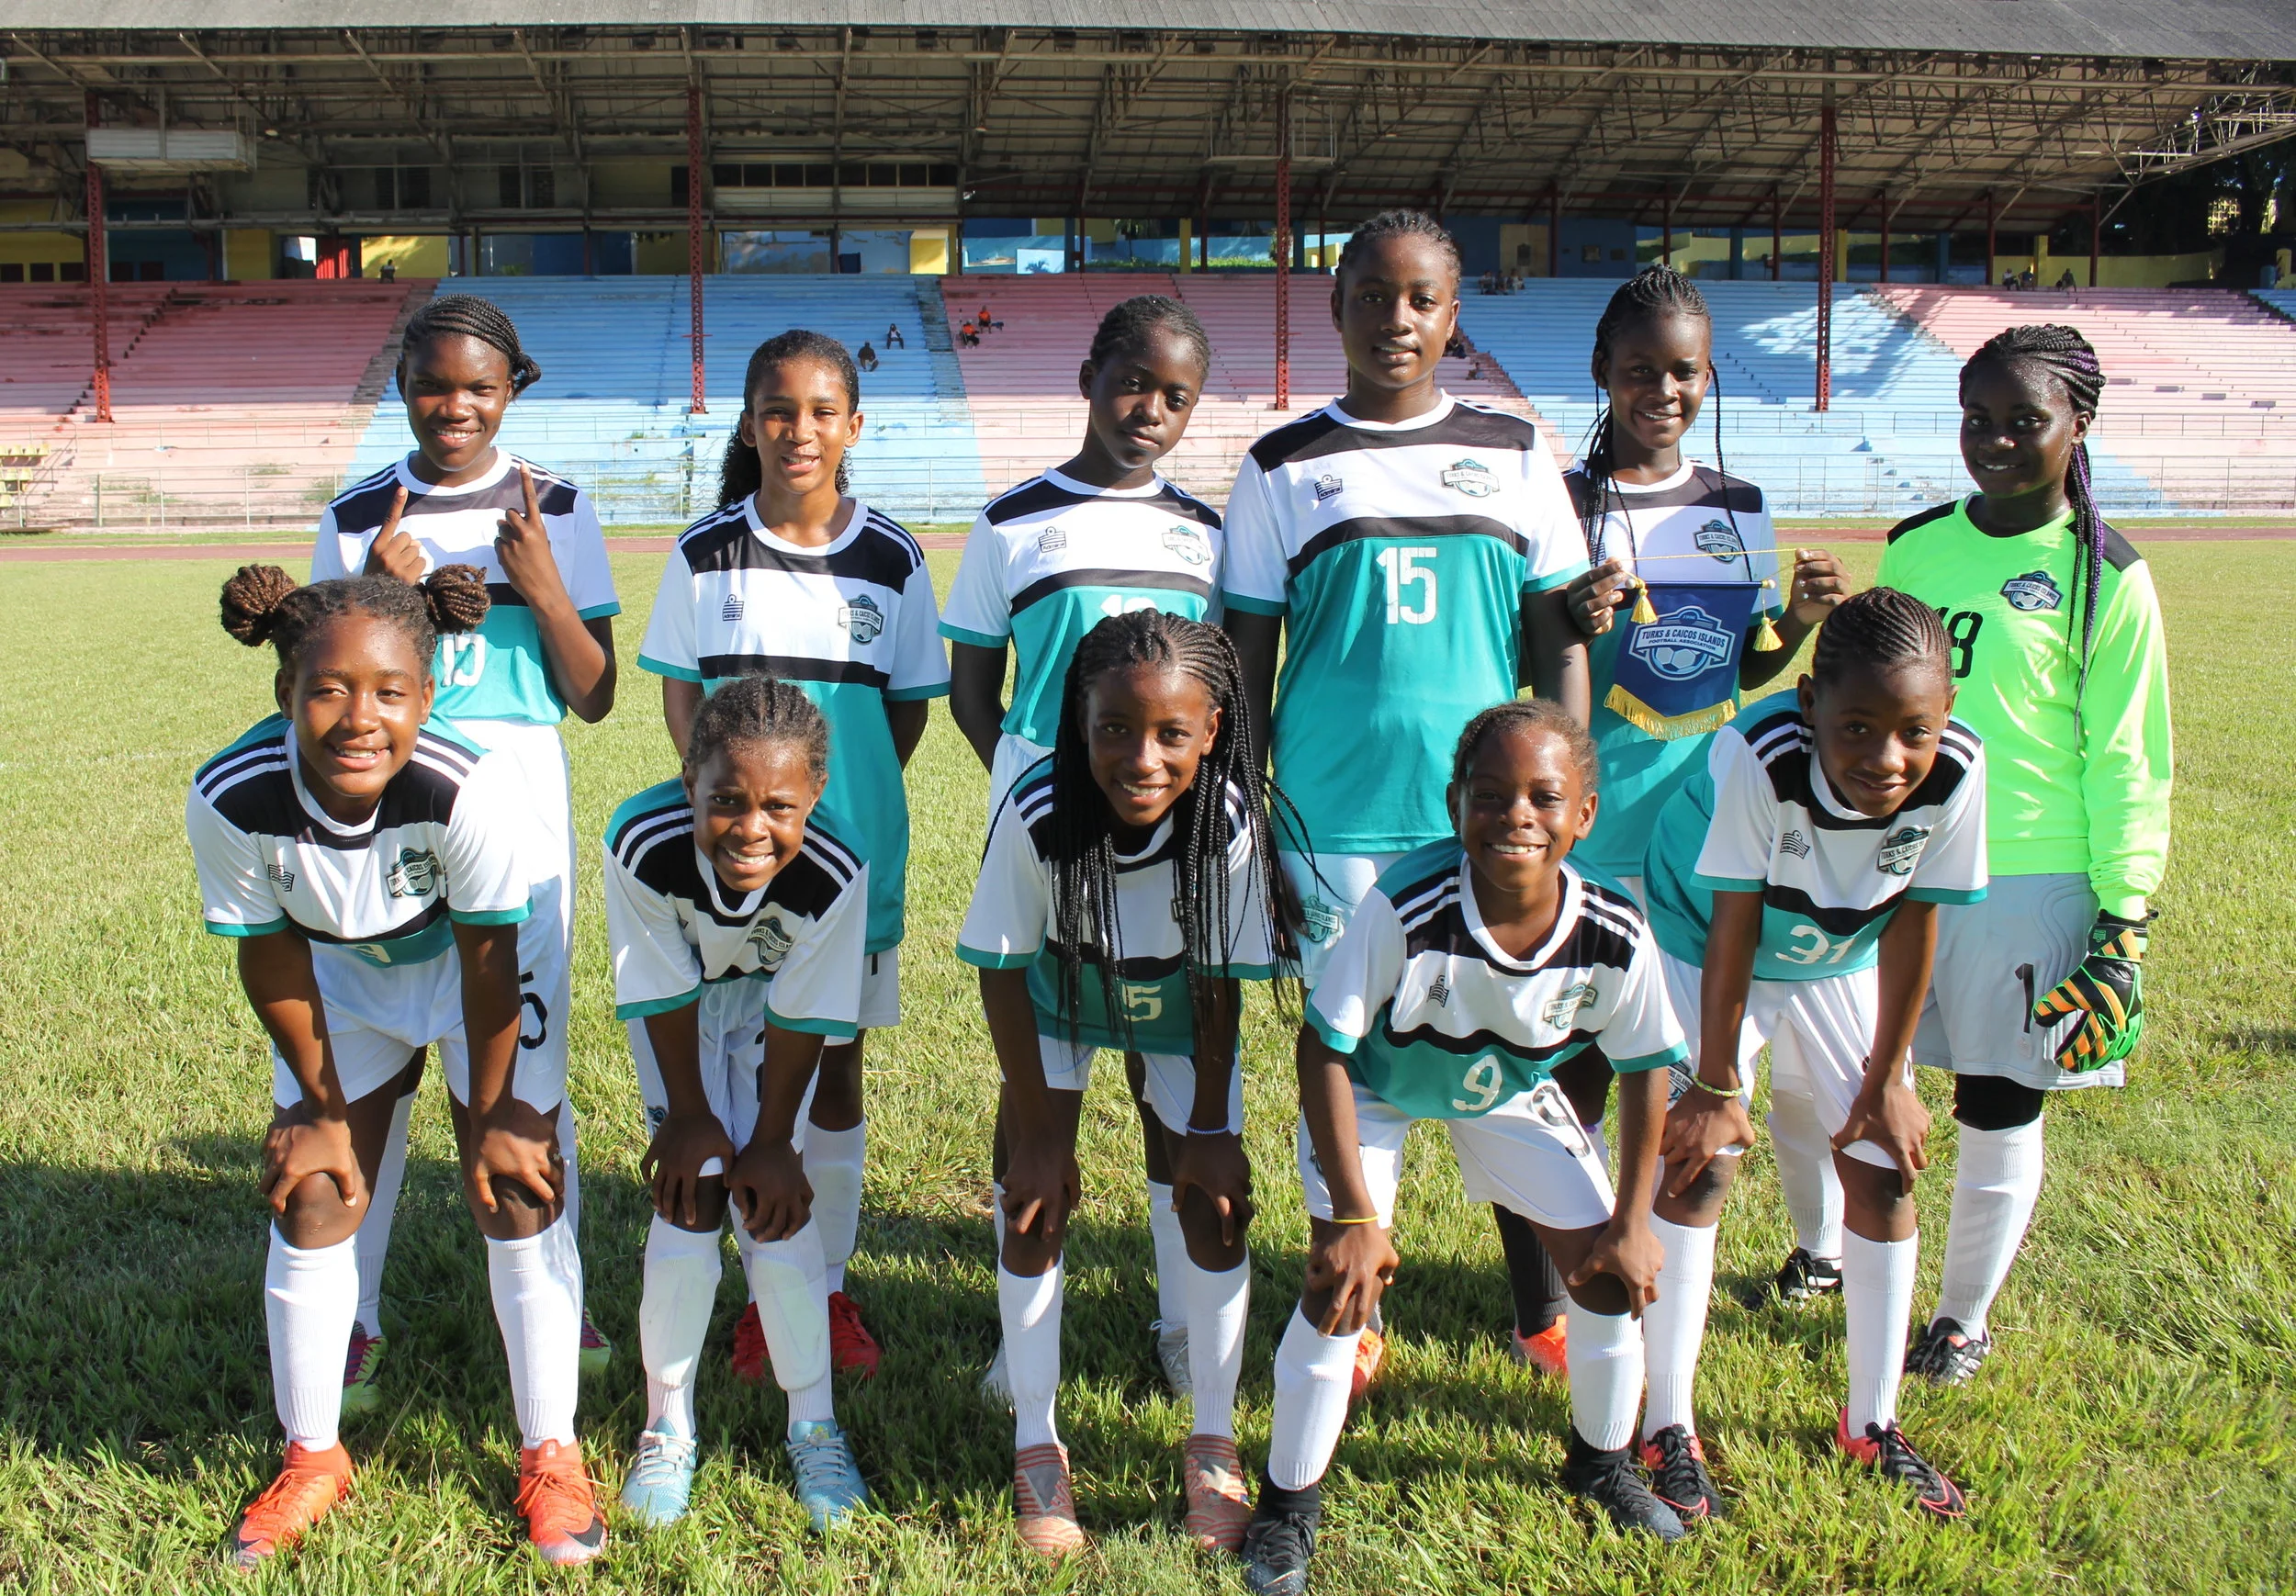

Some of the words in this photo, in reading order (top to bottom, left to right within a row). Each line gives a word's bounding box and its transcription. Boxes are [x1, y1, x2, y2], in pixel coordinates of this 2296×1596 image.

[1376, 547, 1438, 624] 15
[1642, 629, 1666, 640] TURKS
[1665, 629, 1670, 637] &
[1671, 629, 1697, 640] CAICOS
[1698, 632, 1726, 648] ISLANDS
[1679, 638, 1716, 651] ASSOCIATION
[1121, 983, 1163, 1022] 5
[1452, 1054, 1503, 1111] 9
